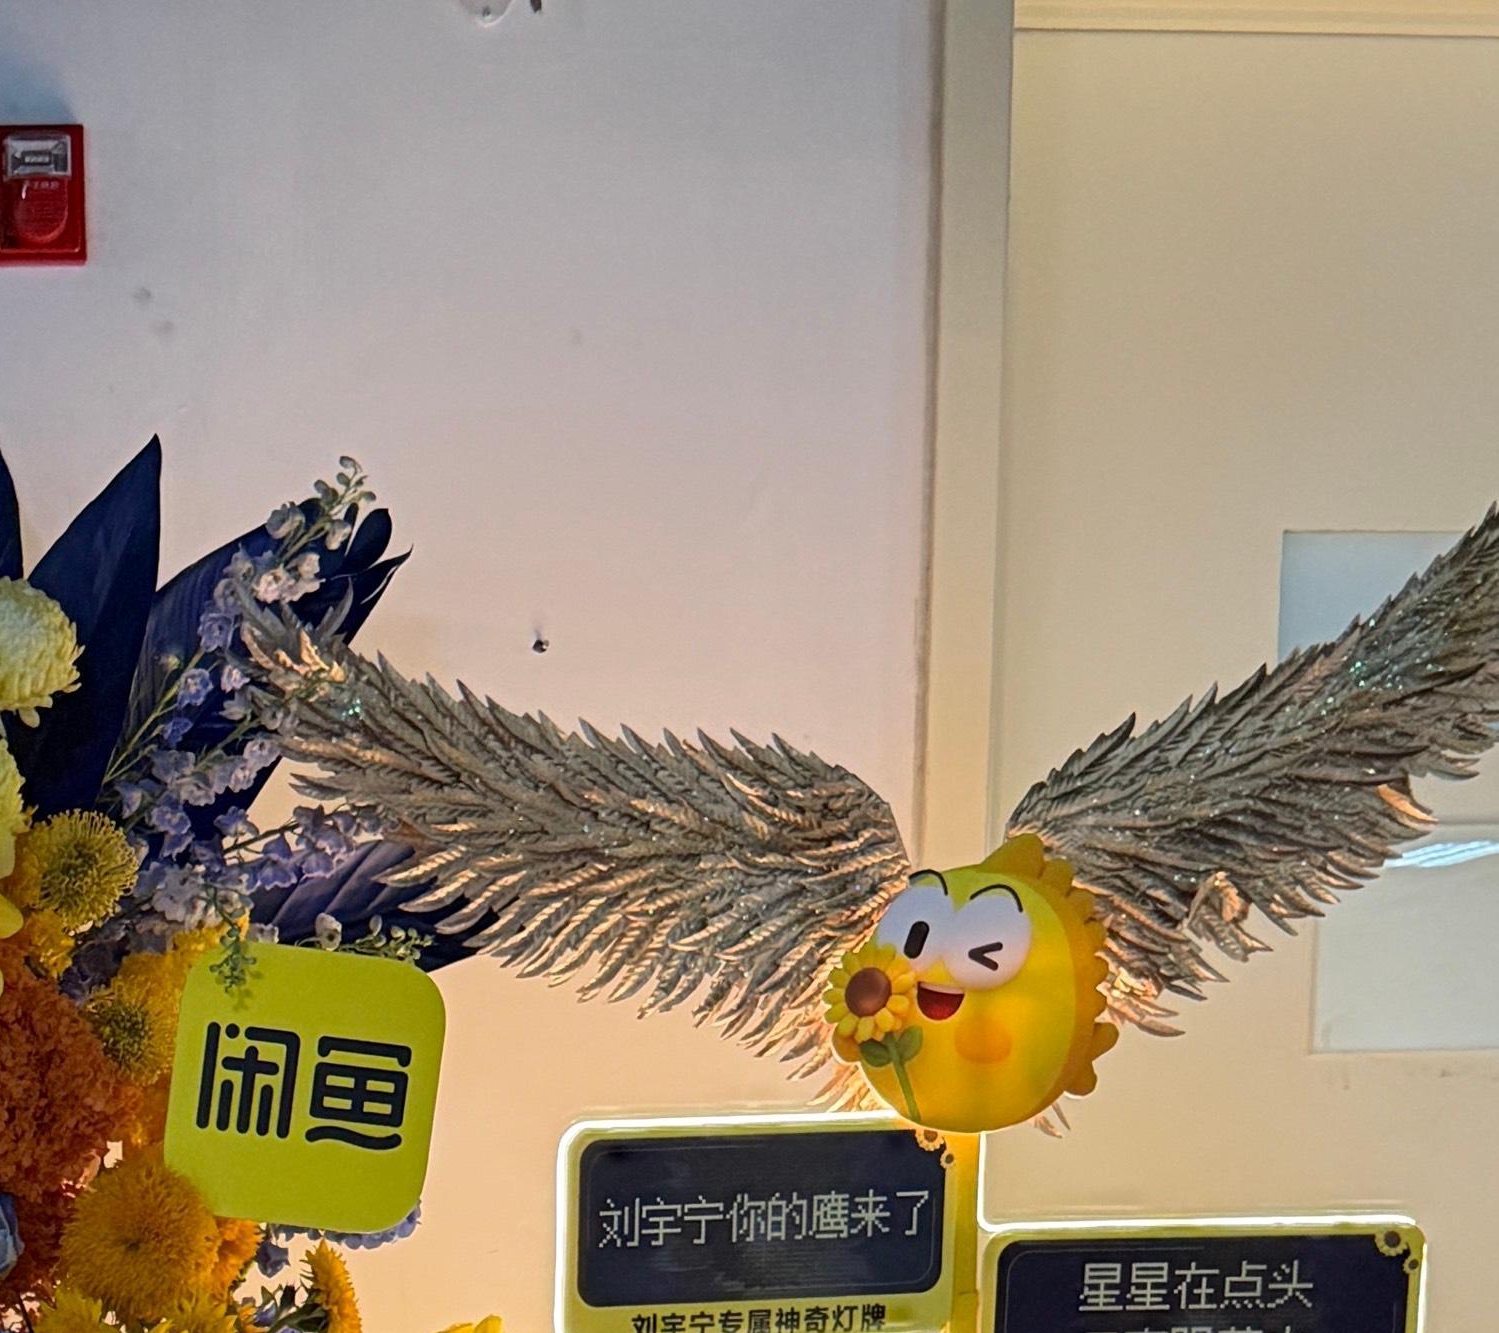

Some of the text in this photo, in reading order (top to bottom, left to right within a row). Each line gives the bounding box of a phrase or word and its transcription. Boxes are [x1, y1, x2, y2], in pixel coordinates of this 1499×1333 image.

[196, 1021, 412, 1150] 闲鱼
[598, 1189, 929, 1248] 刘宇宁你的鹰来了
[1078, 1260, 1314, 1313] 星星在点头
